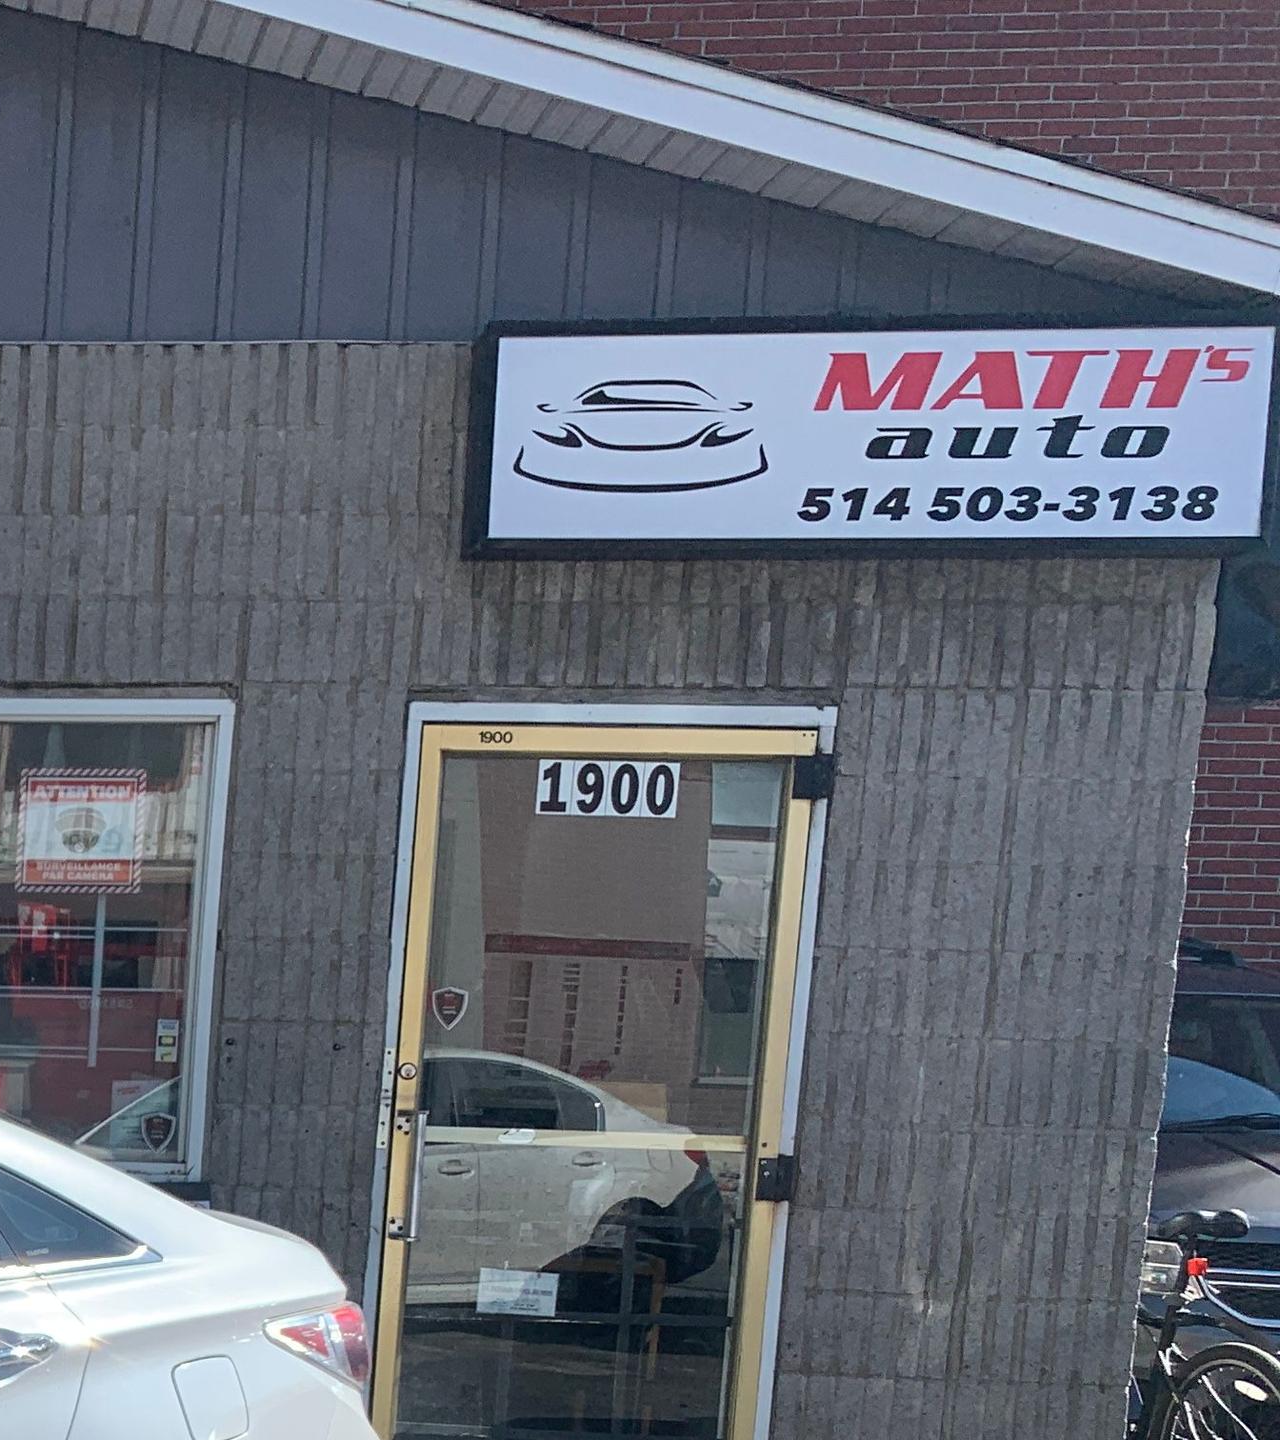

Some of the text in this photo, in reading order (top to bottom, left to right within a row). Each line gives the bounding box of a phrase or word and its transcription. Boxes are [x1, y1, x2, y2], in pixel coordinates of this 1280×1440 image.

[864, 415, 1171, 460] auto
[797, 485, 1220, 523] 514 503-3138
[478, 730, 514, 744] 1900
[32, 784, 132, 800] ATTENTION
[539, 761, 676, 816] 1900
[36, 861, 121, 872] SURVEILLANCE
